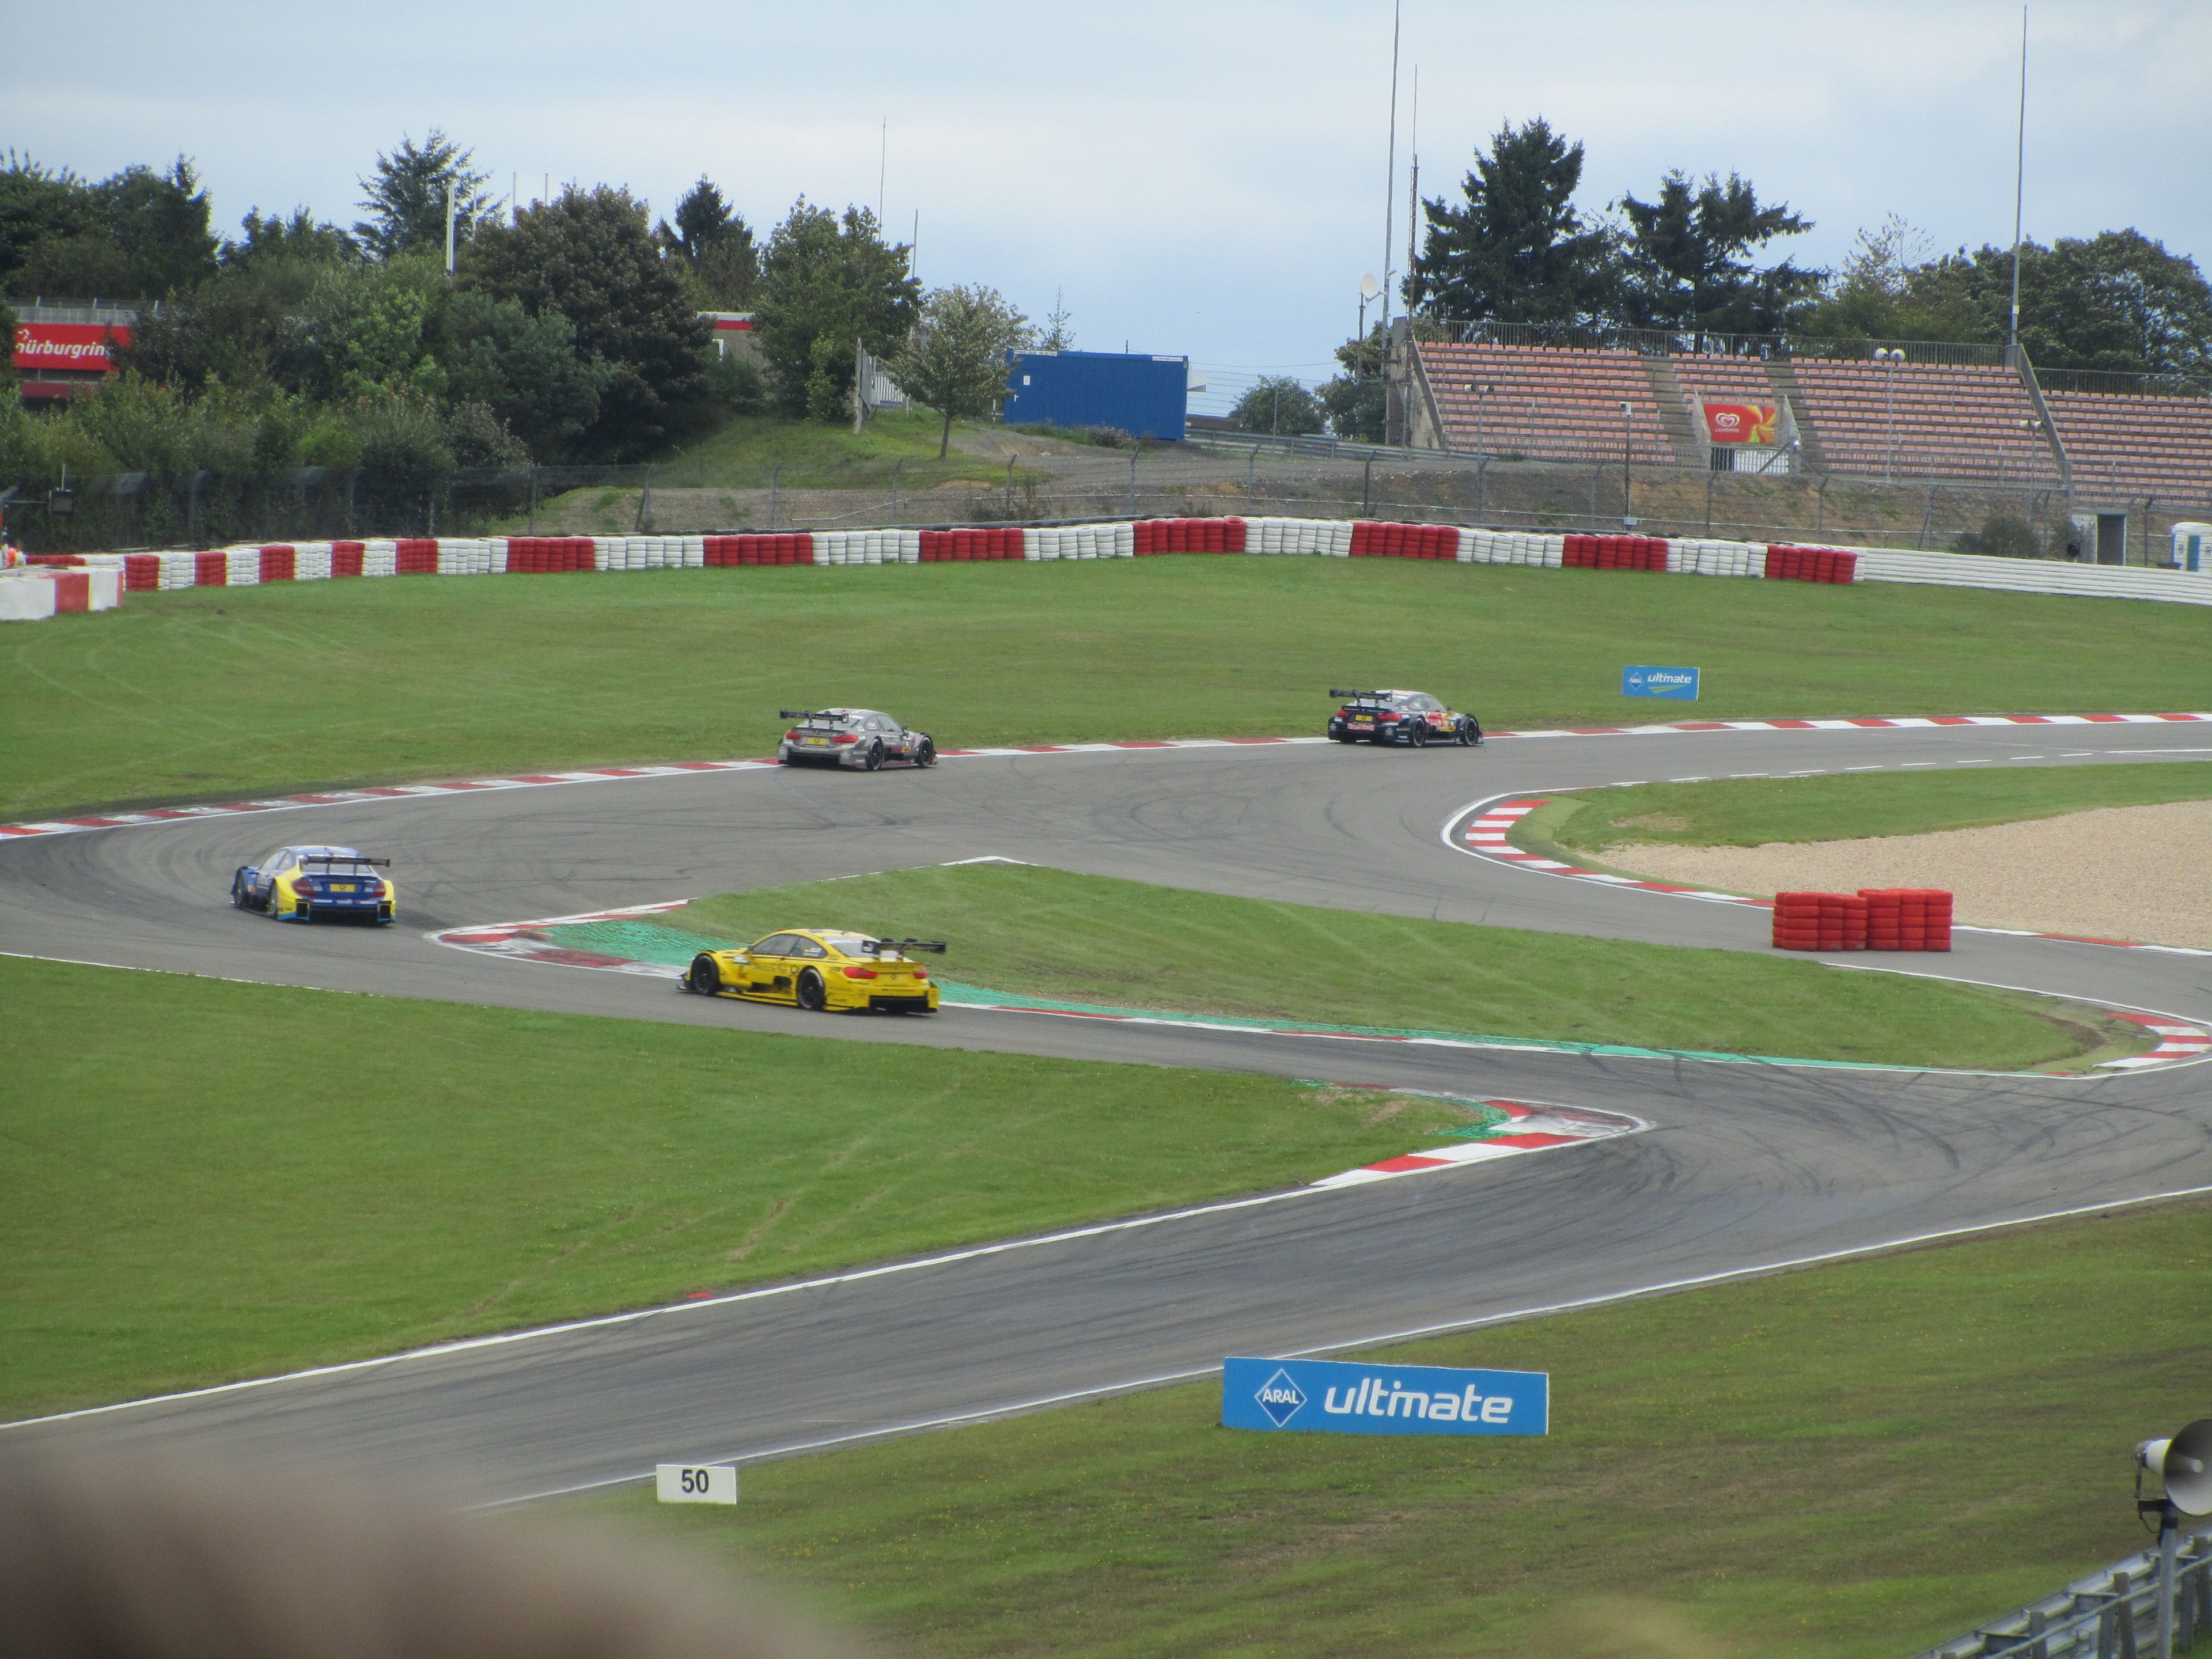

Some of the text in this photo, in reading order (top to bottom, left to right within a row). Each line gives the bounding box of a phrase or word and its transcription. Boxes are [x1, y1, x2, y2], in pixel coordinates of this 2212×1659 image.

[1647, 673, 1692, 684] ultimate
[1262, 1378, 1513, 1423] ARAL ultimate
[681, 1469, 709, 1494] 50
